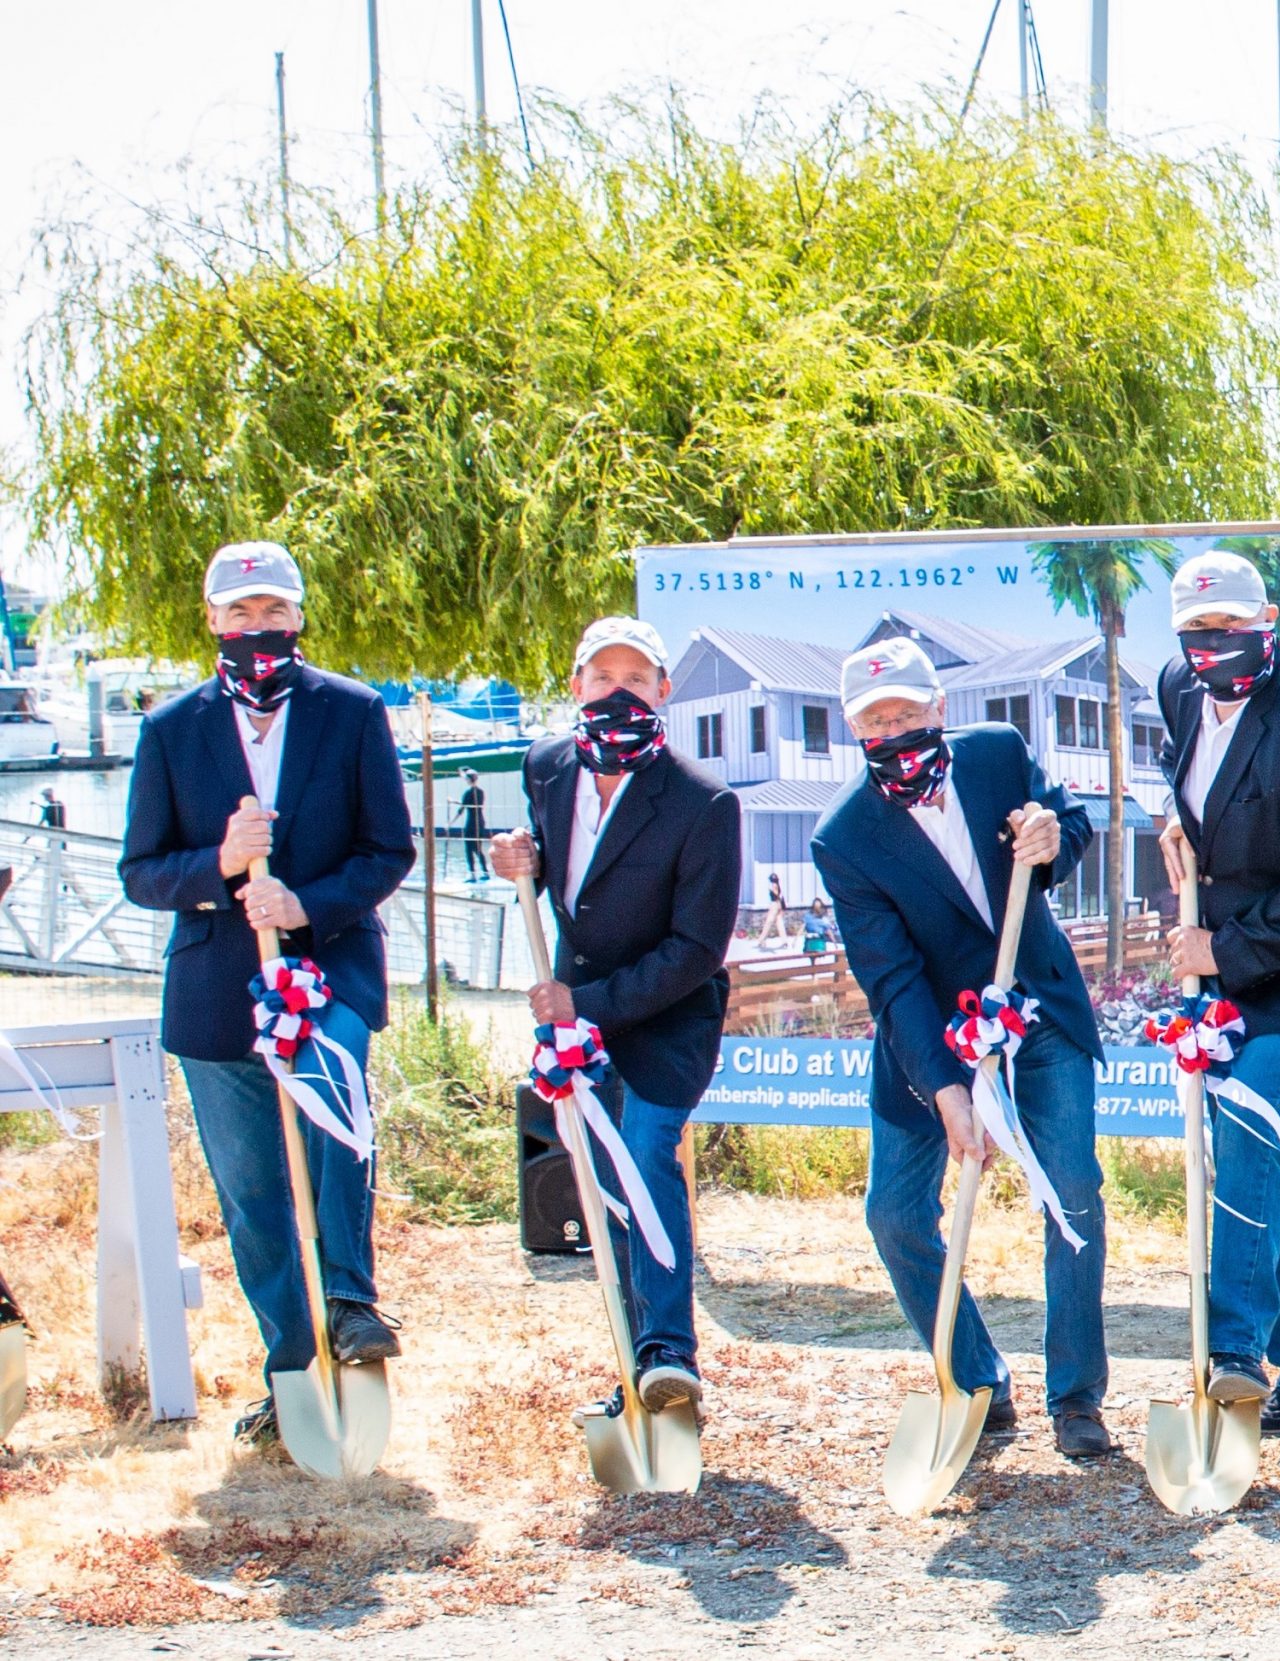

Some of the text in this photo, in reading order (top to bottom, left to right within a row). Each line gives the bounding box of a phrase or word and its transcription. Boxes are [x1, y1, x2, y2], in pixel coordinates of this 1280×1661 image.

[997, 566, 1019, 585] W
[733, 1046, 799, 1075] Club
[807, 1050, 834, 1076] at
